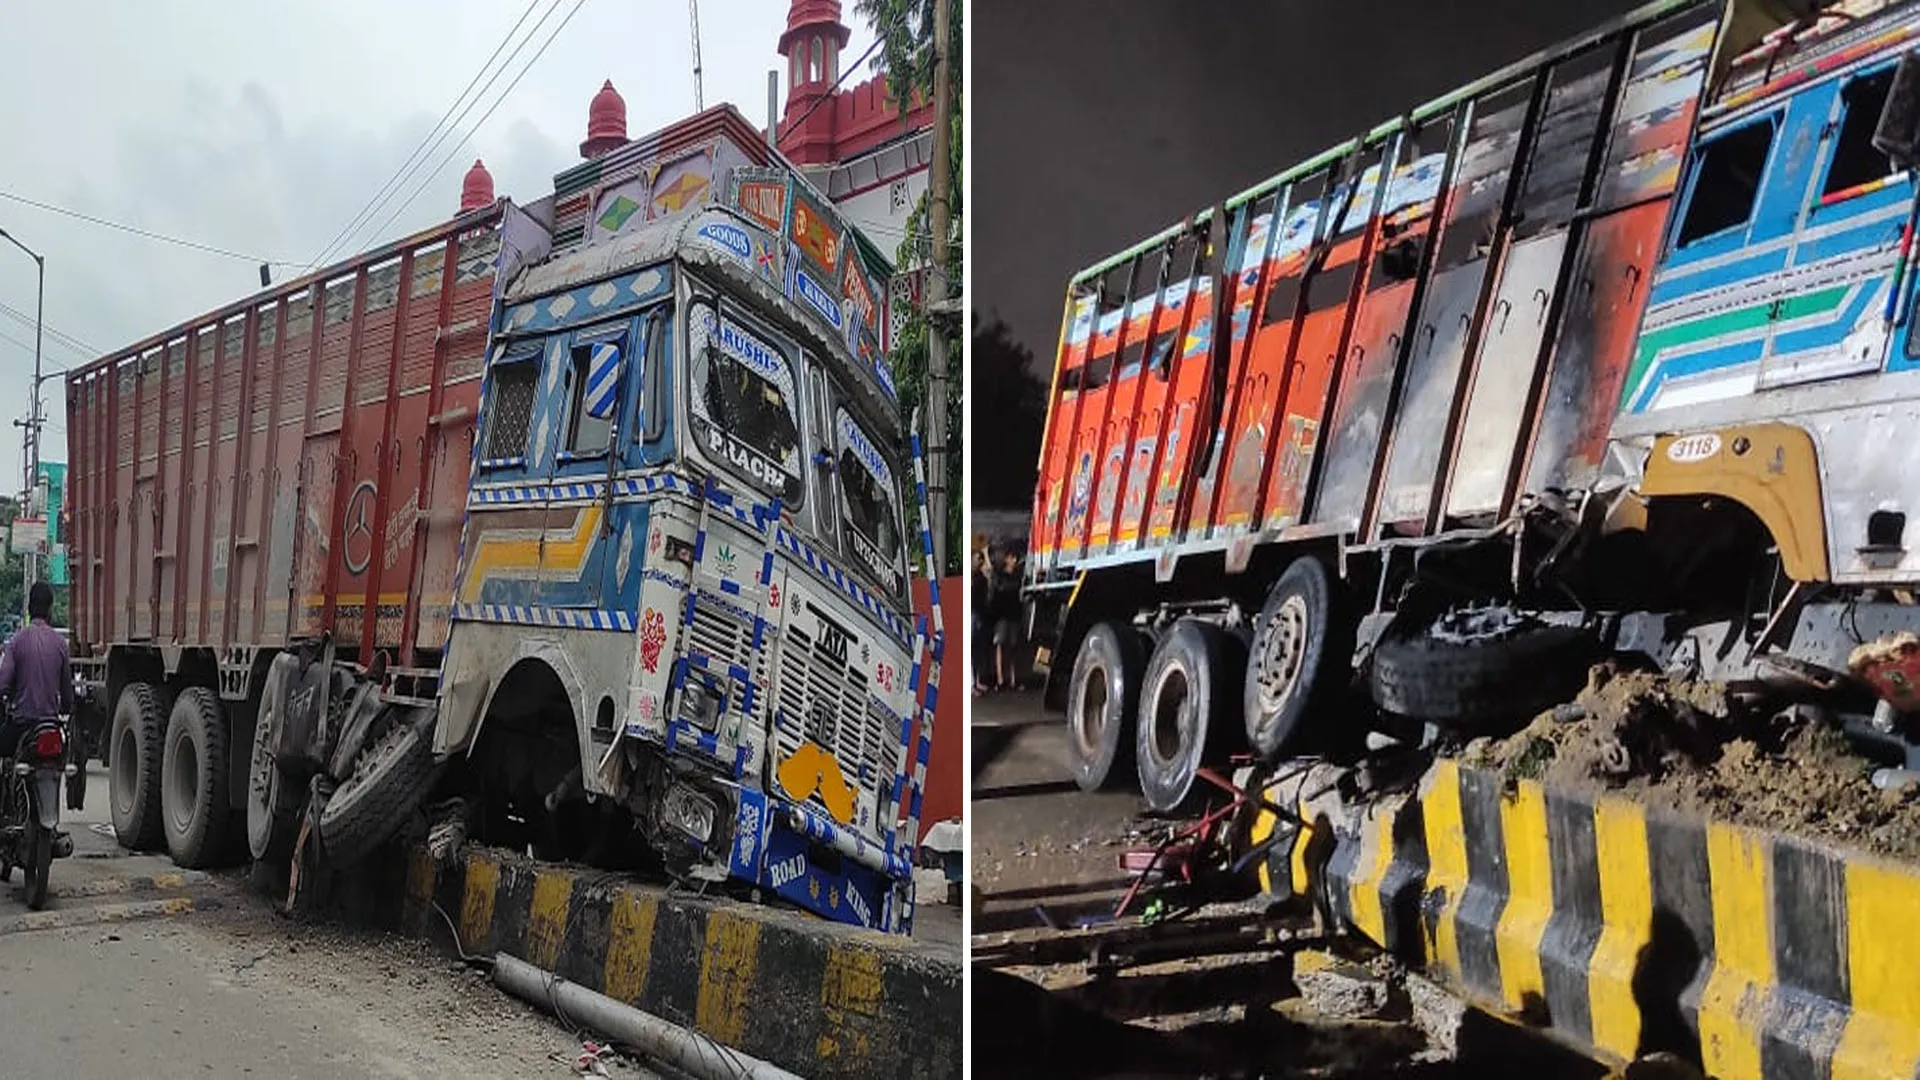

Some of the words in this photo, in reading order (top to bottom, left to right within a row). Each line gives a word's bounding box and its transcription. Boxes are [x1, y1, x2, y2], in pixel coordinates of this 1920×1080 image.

[707, 226, 748, 254] GOODS
[1674, 436, 1715, 458] 3118
[816, 618, 848, 664] TATA
[770, 853, 806, 889] ROAD
[845, 878, 871, 928] KING
